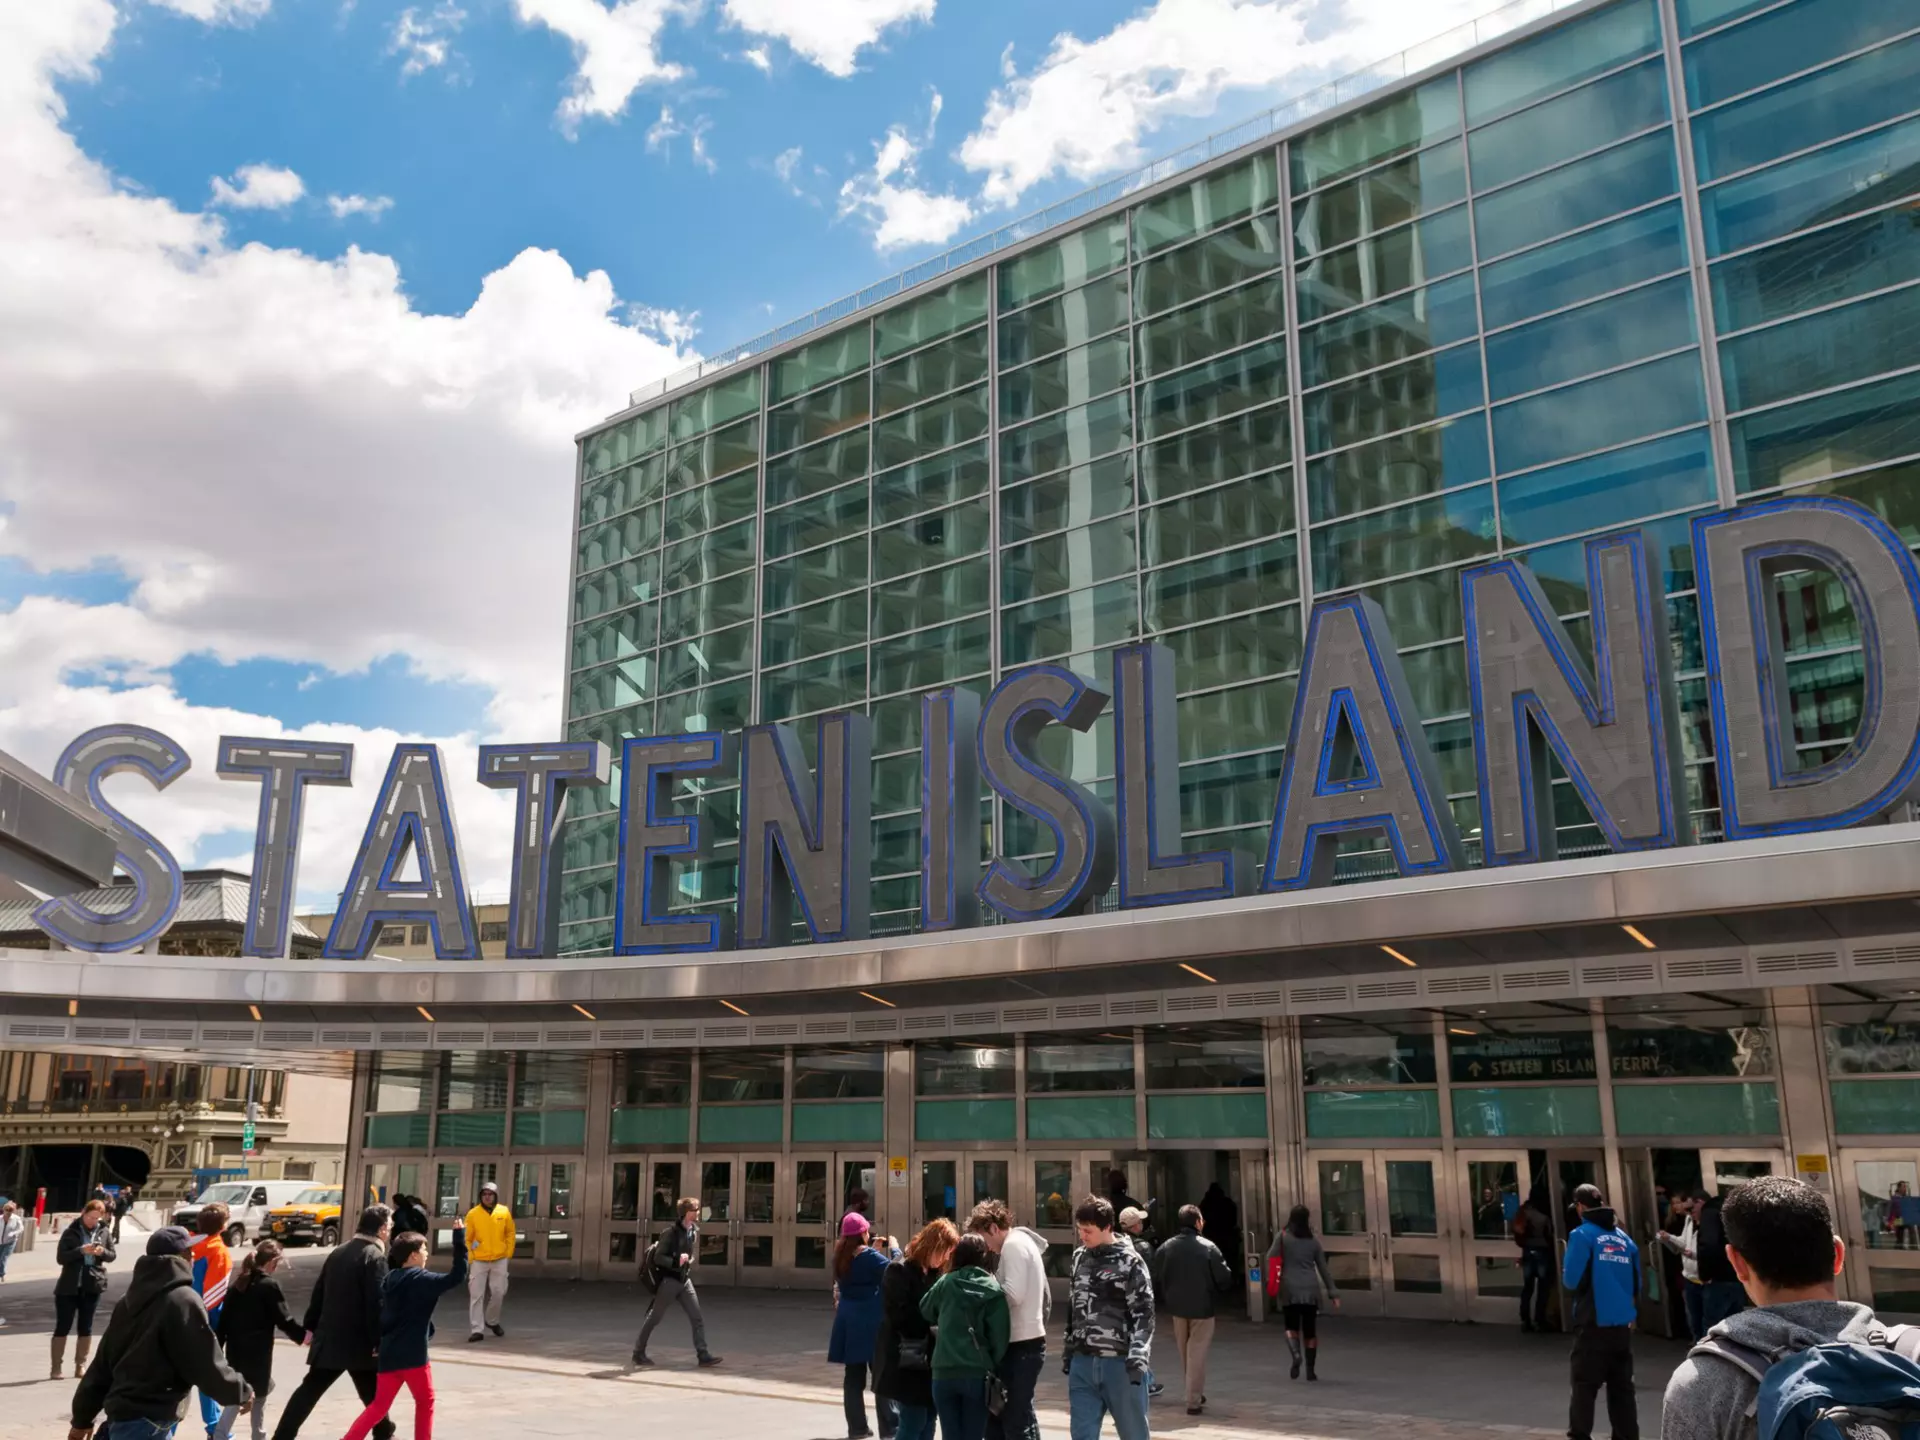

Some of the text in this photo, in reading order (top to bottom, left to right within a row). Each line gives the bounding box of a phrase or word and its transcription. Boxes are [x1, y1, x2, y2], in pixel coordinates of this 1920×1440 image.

[31, 494, 1920, 960] STATEN ISLAND
[1491, 1055, 1660, 1076] STATEN ISLAN FERRY
